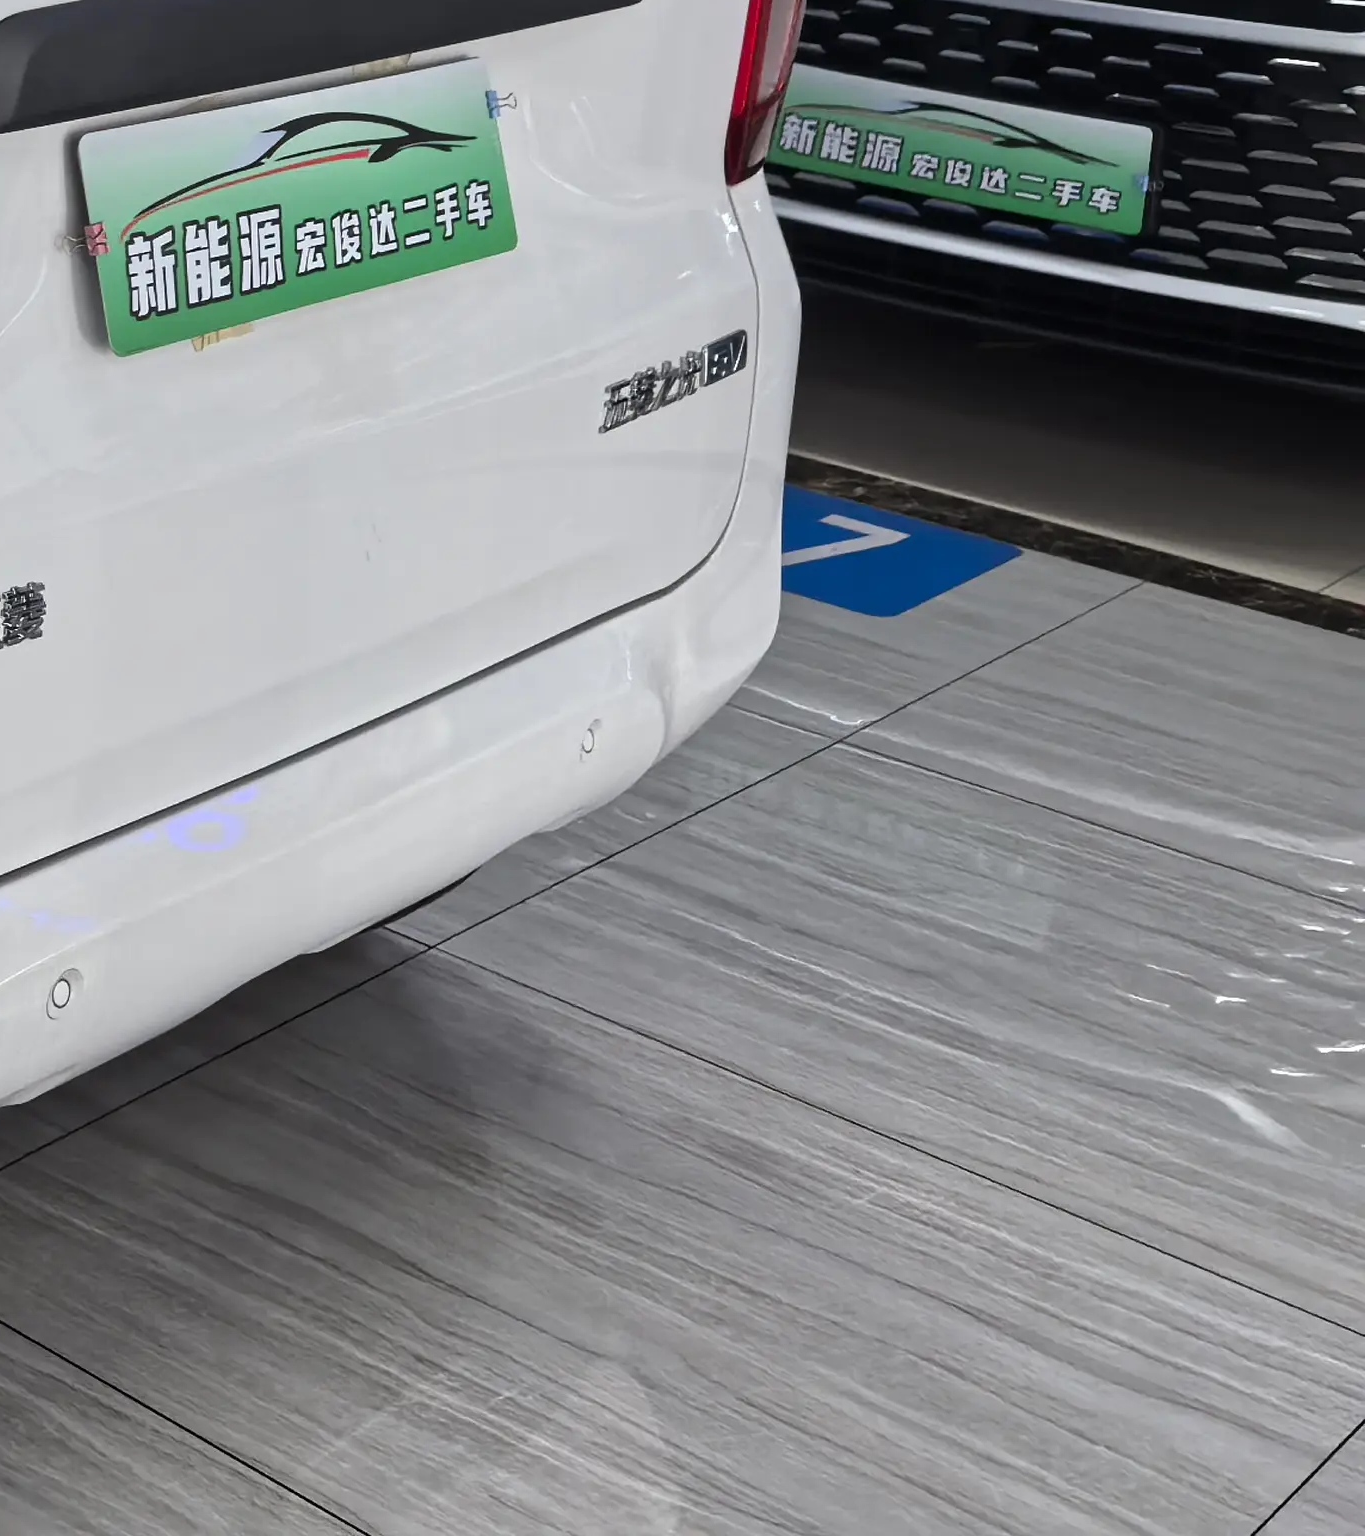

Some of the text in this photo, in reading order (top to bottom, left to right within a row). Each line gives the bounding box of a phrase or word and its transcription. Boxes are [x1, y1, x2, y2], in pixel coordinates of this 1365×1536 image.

[777, 112, 1122, 216] 新能源 宏俊达二手车
[125, 178, 496, 322] 新能源 宏俊达二手车
